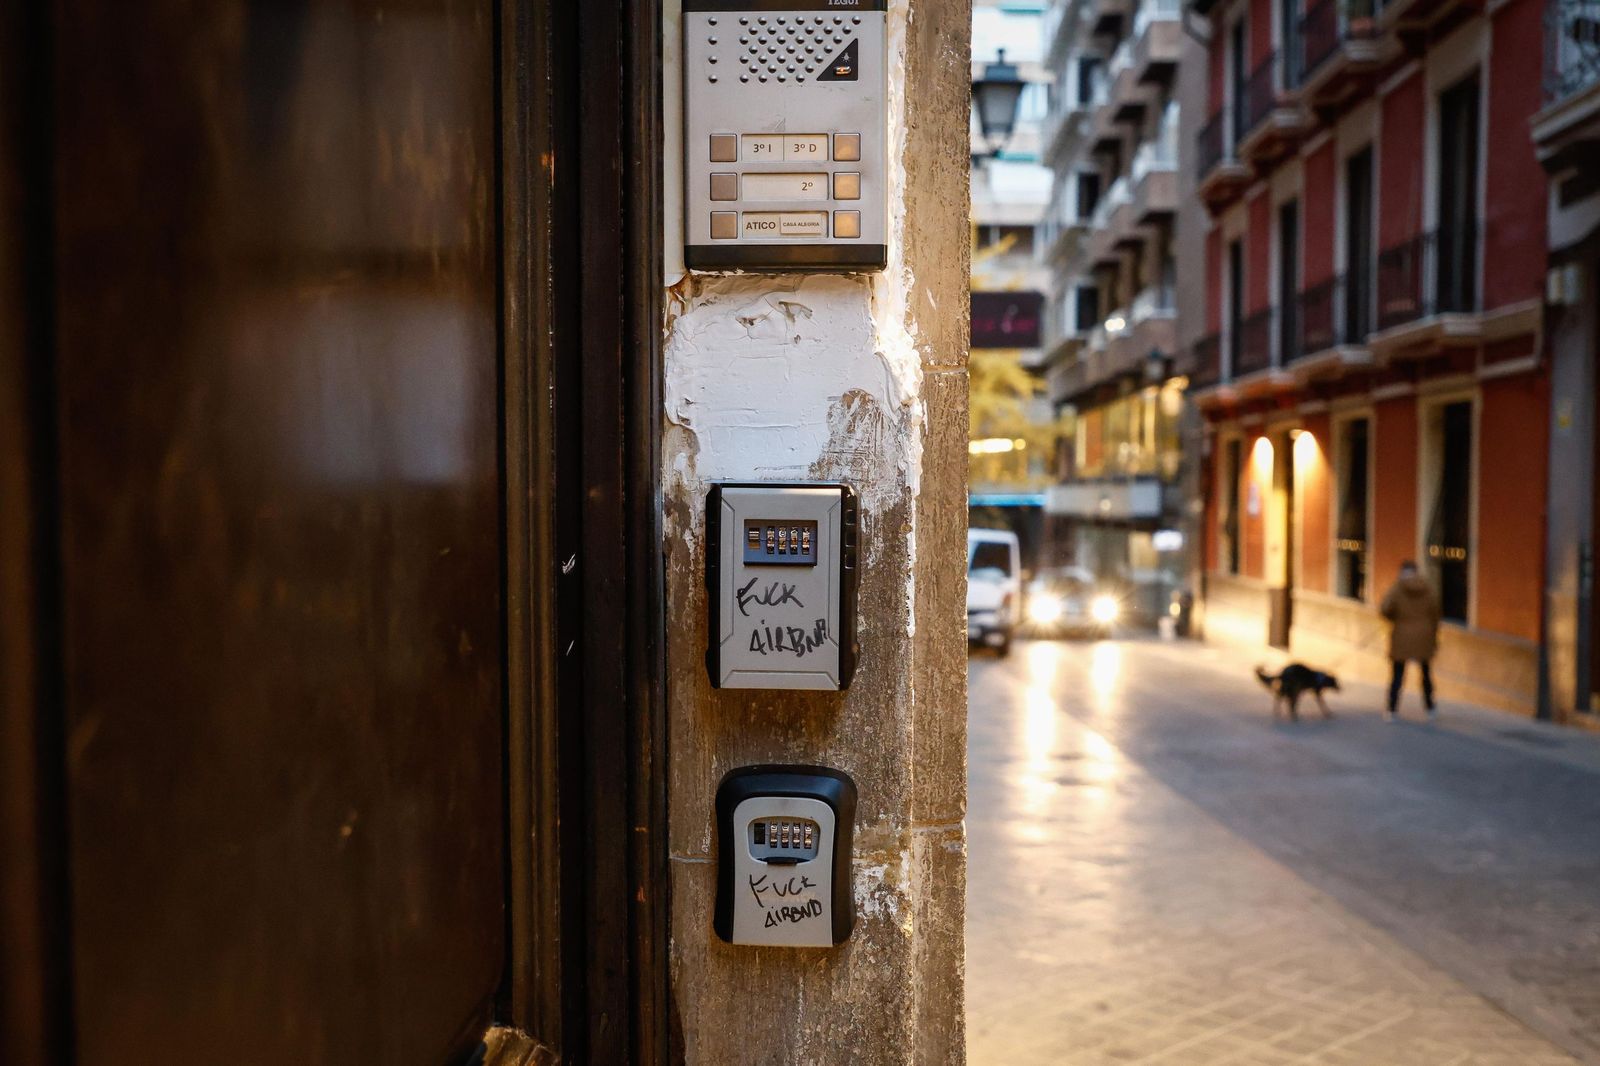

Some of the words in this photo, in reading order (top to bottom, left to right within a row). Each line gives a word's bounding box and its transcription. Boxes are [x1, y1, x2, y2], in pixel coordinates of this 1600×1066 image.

[809, 143, 817, 153] D
[745, 221, 776, 230] ATICO
[736, 577, 804, 616] FUCK
